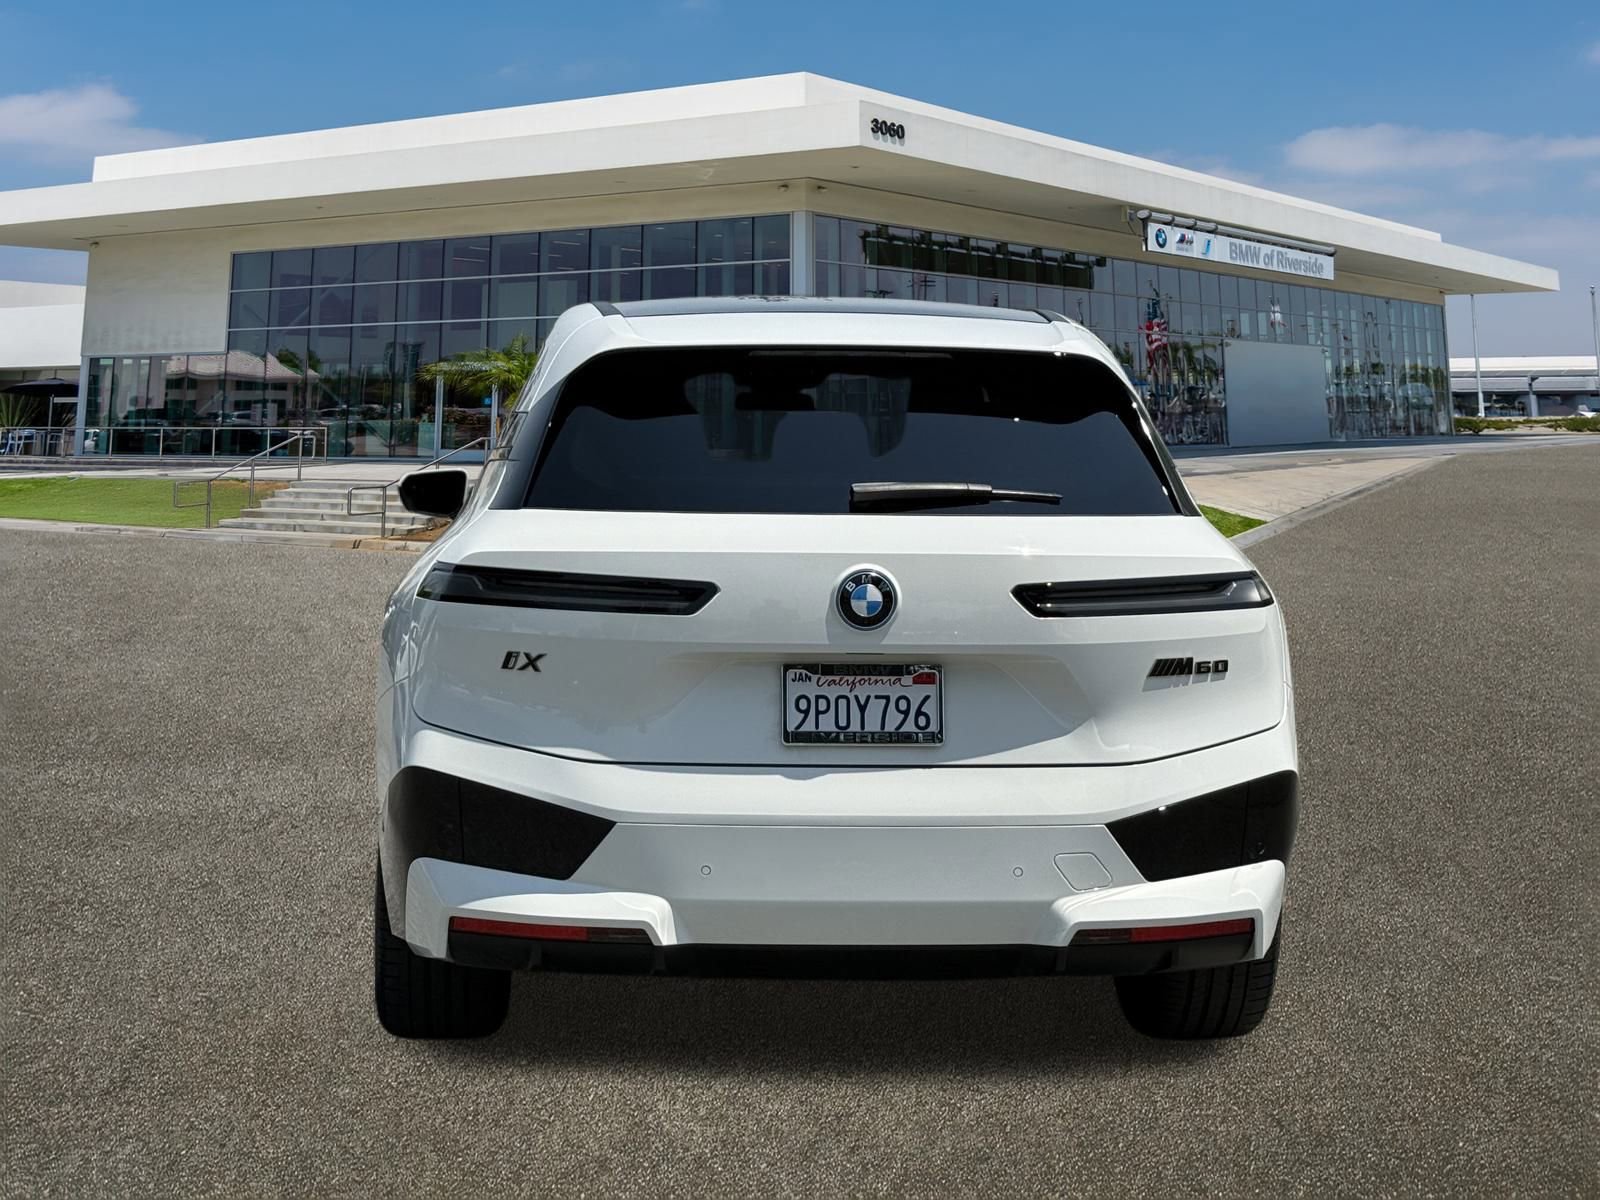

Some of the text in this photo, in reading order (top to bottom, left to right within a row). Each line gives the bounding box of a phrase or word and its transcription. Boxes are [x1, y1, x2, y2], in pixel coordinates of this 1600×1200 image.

[871, 118, 905, 139] 3060
[1229, 241, 1325, 275] BMW of Riverside
[501, 650, 547, 672] iX
[791, 672, 812, 683] JAN
[816, 675, 912, 692] California
